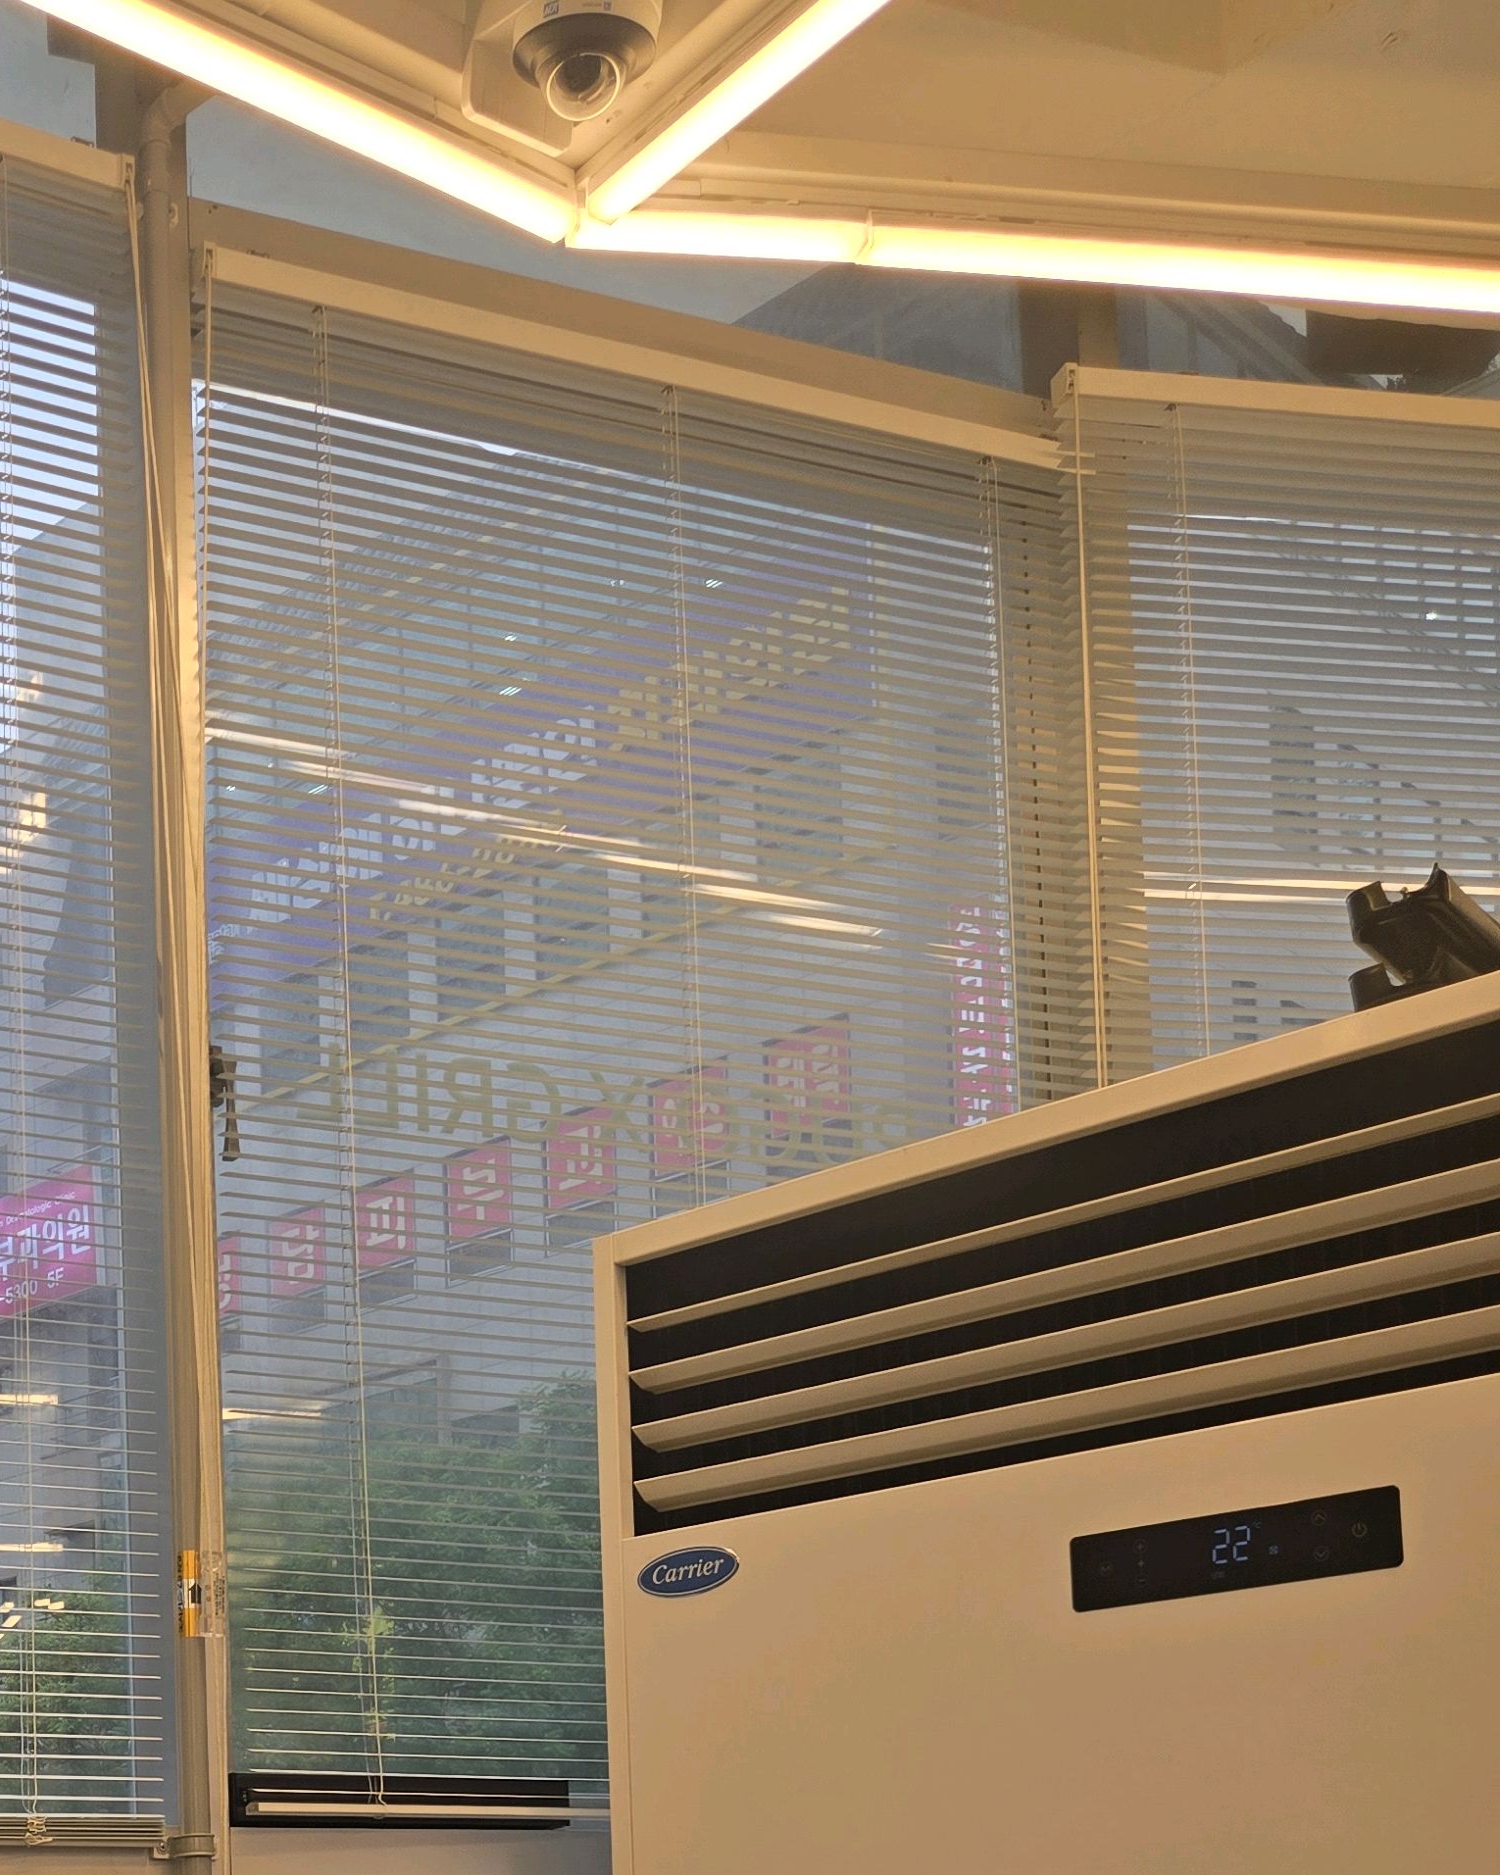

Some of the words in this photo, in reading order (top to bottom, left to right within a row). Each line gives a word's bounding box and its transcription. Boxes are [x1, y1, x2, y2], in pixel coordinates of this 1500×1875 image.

[46, 1266, 65, 1289] 5F
[1211, 1525, 1251, 1564] 22
[652, 1559, 724, 1585] Carrier
